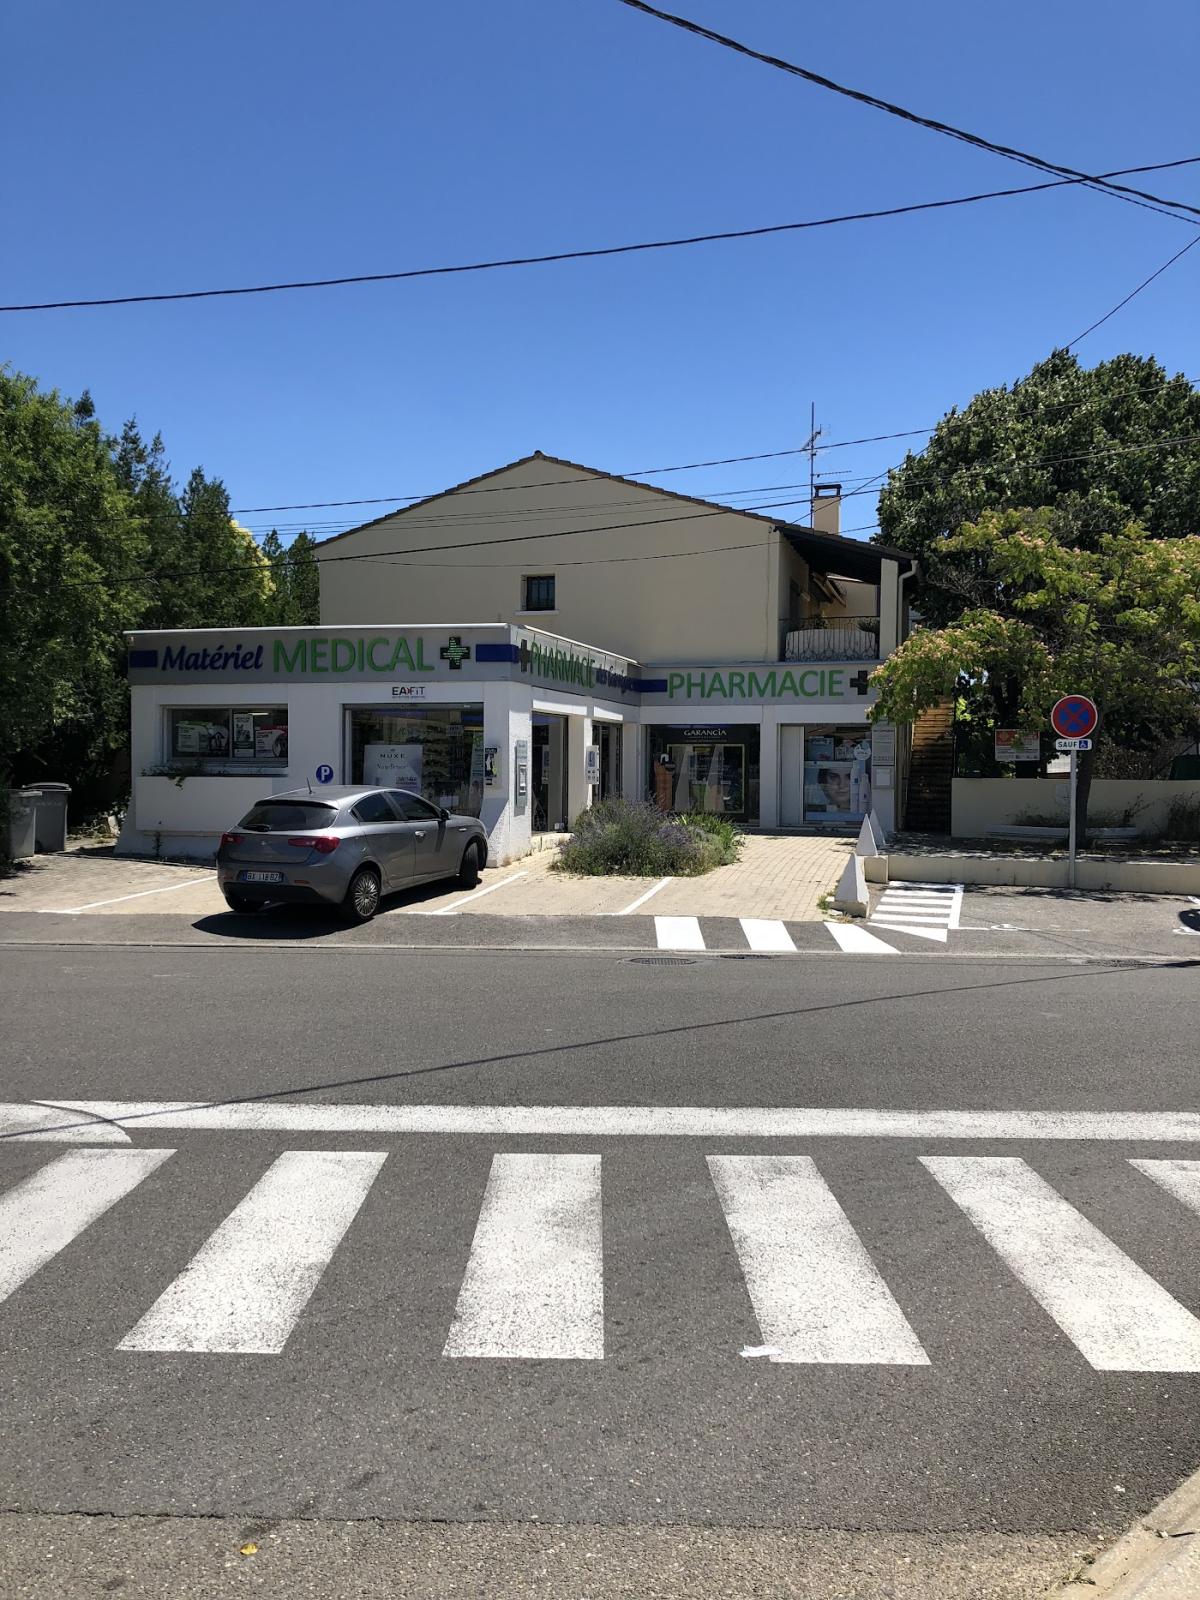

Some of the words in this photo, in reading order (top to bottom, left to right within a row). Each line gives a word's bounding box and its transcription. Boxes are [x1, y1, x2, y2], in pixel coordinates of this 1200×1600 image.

[162, 645, 264, 672] Matériel
[273, 637, 435, 673] MEDICAL
[531, 641, 596, 689] PHARMACIE
[669, 670, 845, 699] PHARMACIE
[683, 728, 728, 737] GARANCIA
